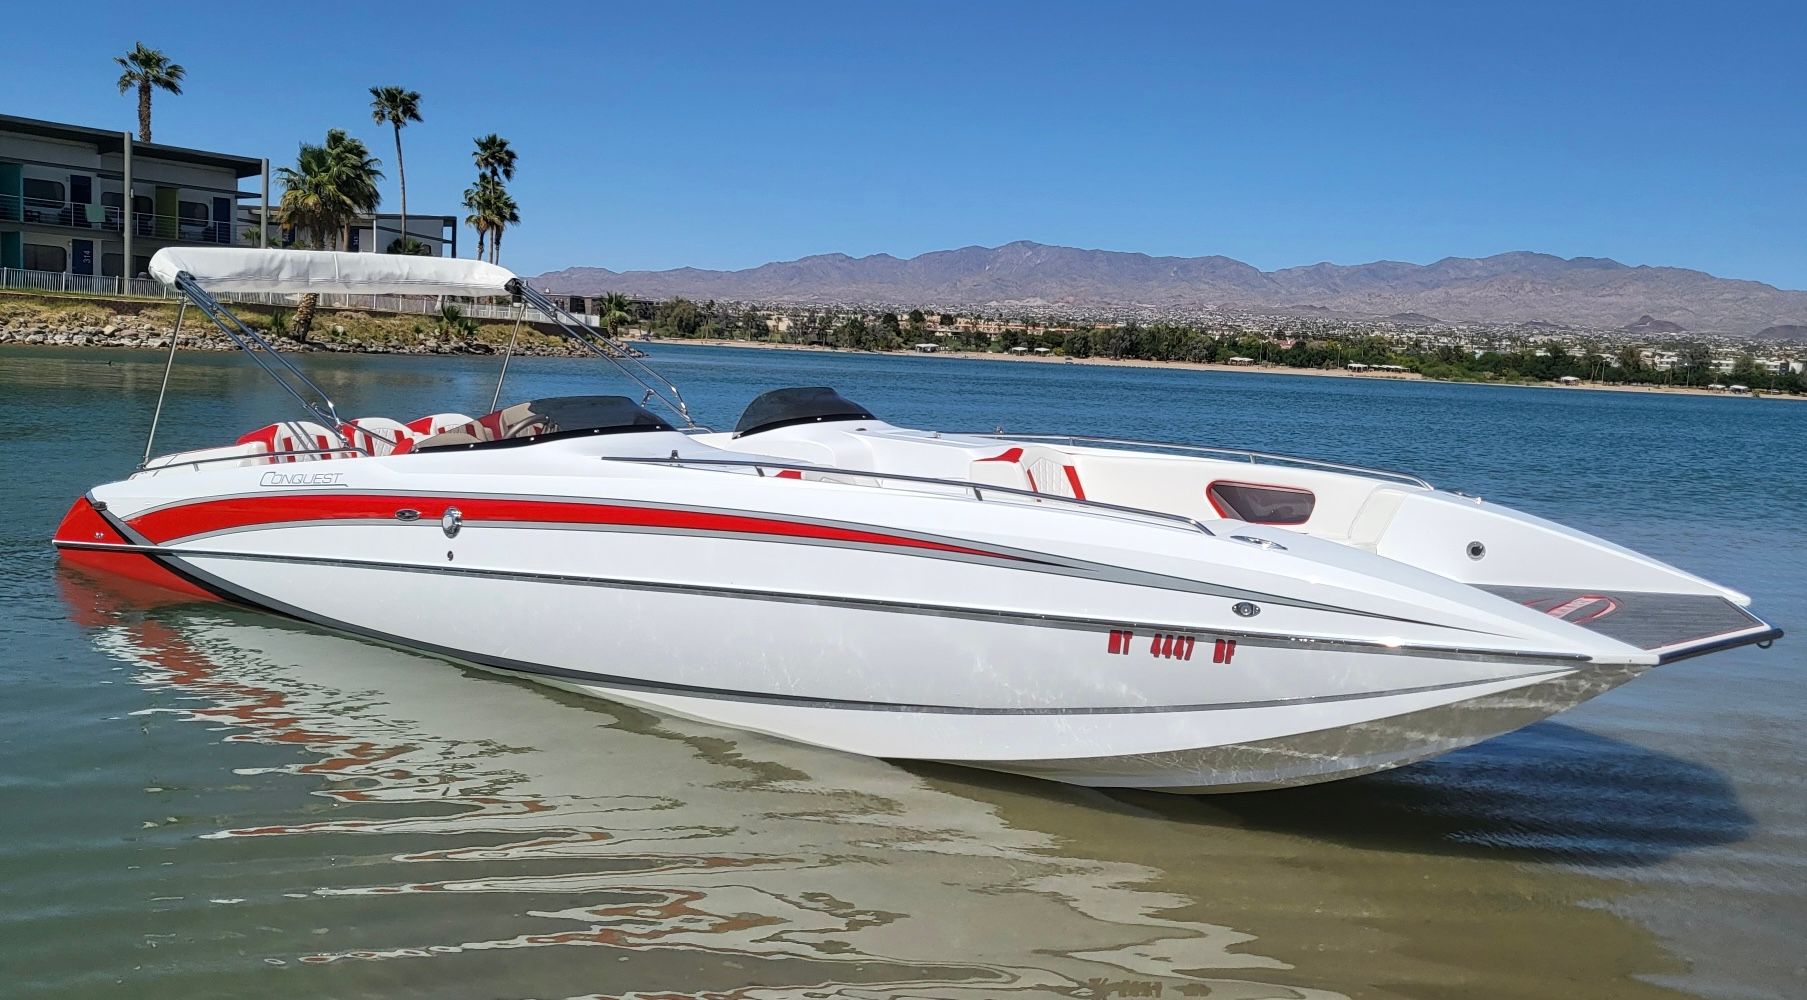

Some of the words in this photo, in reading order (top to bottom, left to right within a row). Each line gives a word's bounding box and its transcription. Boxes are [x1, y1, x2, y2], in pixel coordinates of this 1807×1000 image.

[83, 250, 91, 264] 314
[260, 471, 348, 487] CONQUEST
[1150, 633, 1195, 661] 4447
